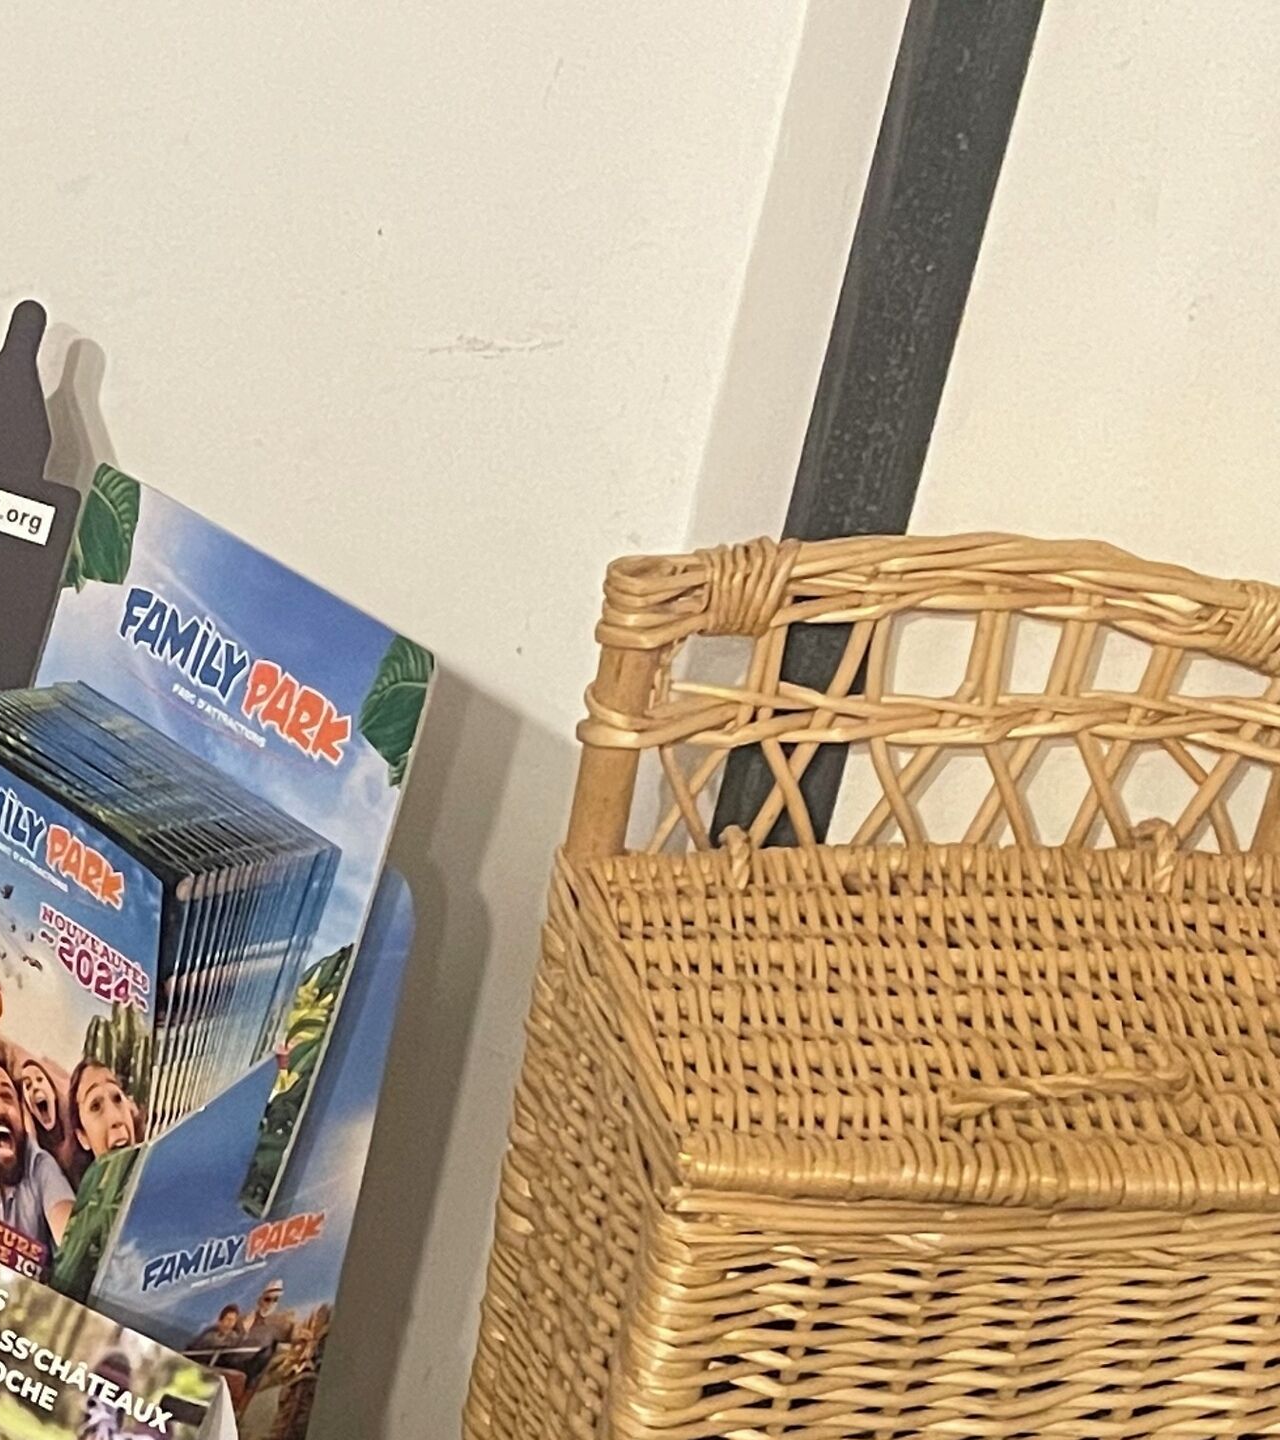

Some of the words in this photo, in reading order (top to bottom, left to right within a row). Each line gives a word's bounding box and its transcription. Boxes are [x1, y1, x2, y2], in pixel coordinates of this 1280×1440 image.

[241, 659, 351, 765] PARK
[46, 824, 124, 910] PARK
[41, 902, 150, 993] NOUVEAUTÉS
[58, 936, 130, 1003] 2024
[245, 1211, 325, 1263] PARK
